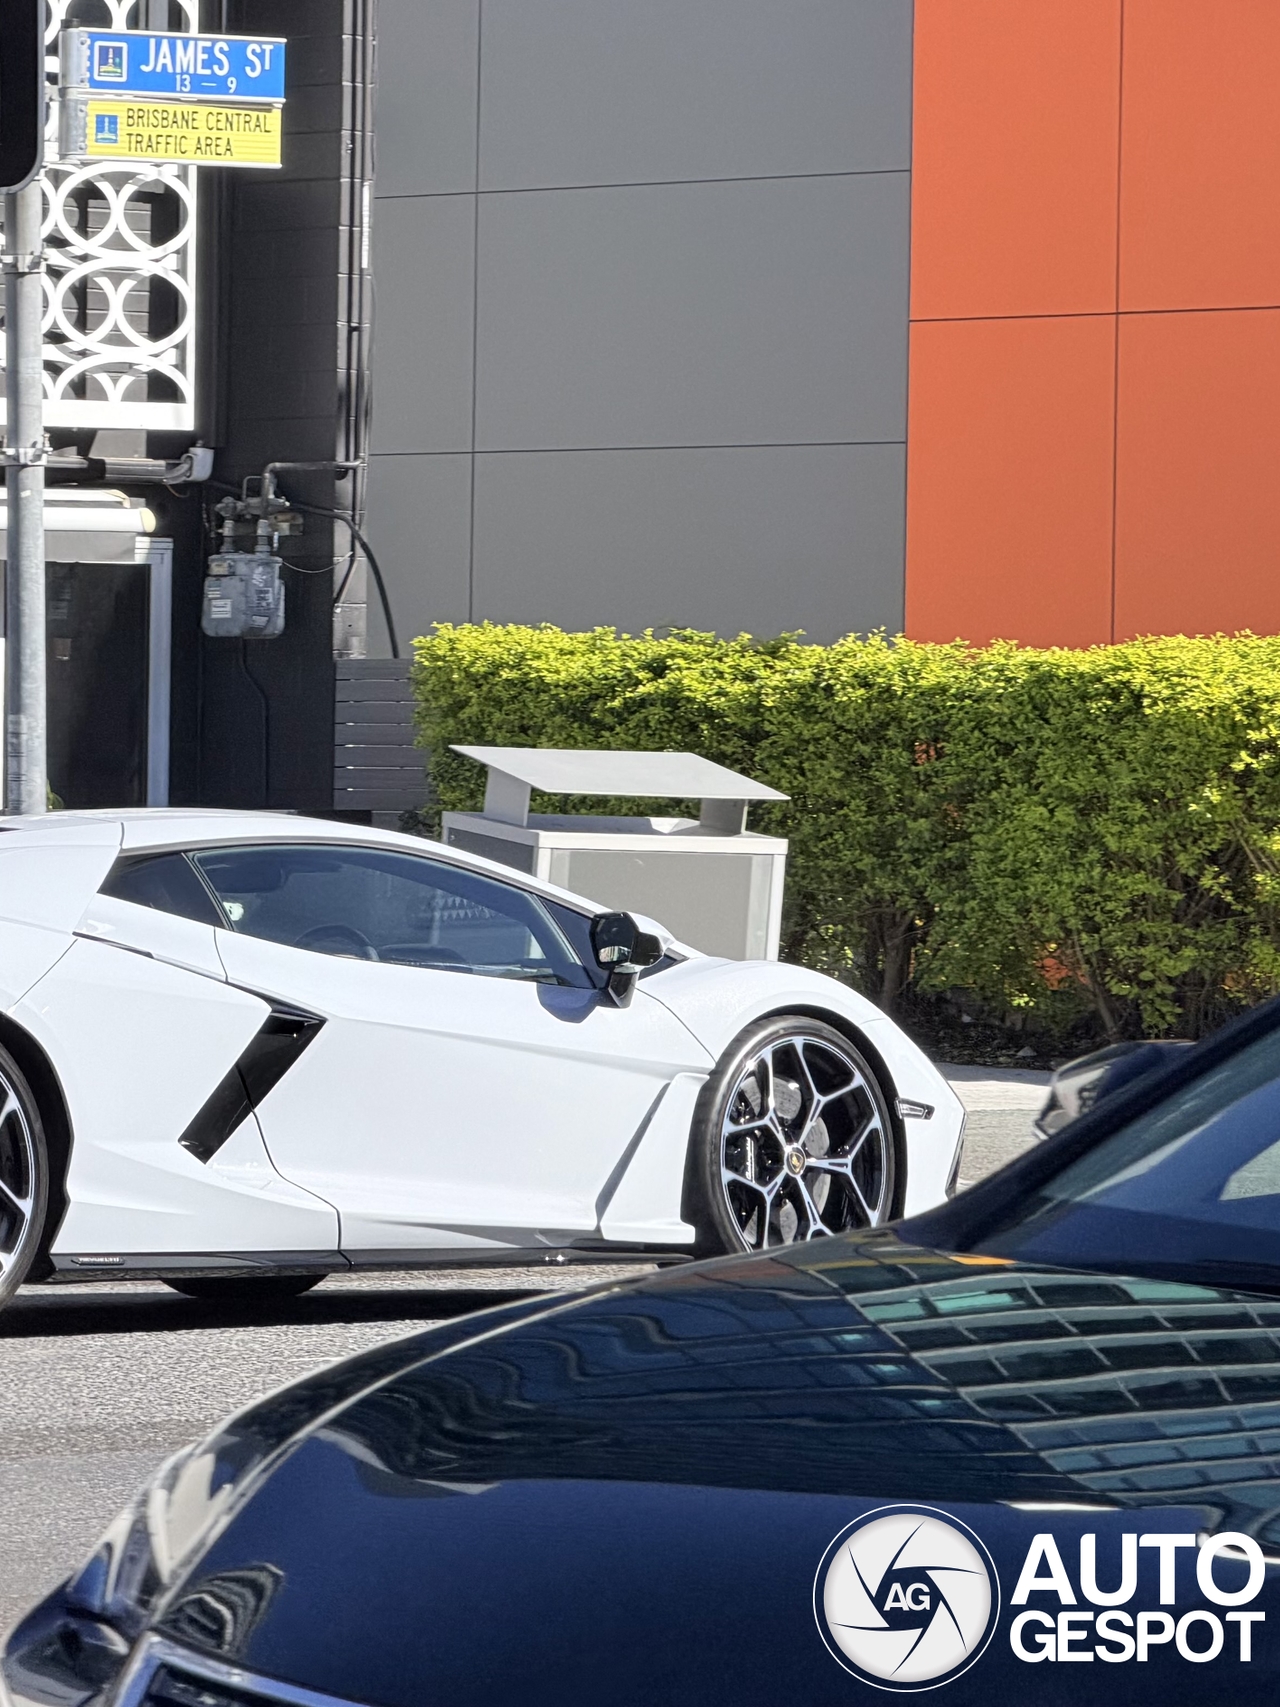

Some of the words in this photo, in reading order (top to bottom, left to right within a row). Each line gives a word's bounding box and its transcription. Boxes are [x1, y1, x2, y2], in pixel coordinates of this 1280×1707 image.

[140, 38, 230, 77] JAMES
[245, 44, 274, 78] ST
[176, 74, 191, 92] 13
[227, 76, 237, 94] 9
[126, 108, 199, 131] BRISBANE
[206, 111, 272, 134] CENTRAL
[126, 133, 188, 155] TRAFFIC
[194, 137, 233, 157] AREA
